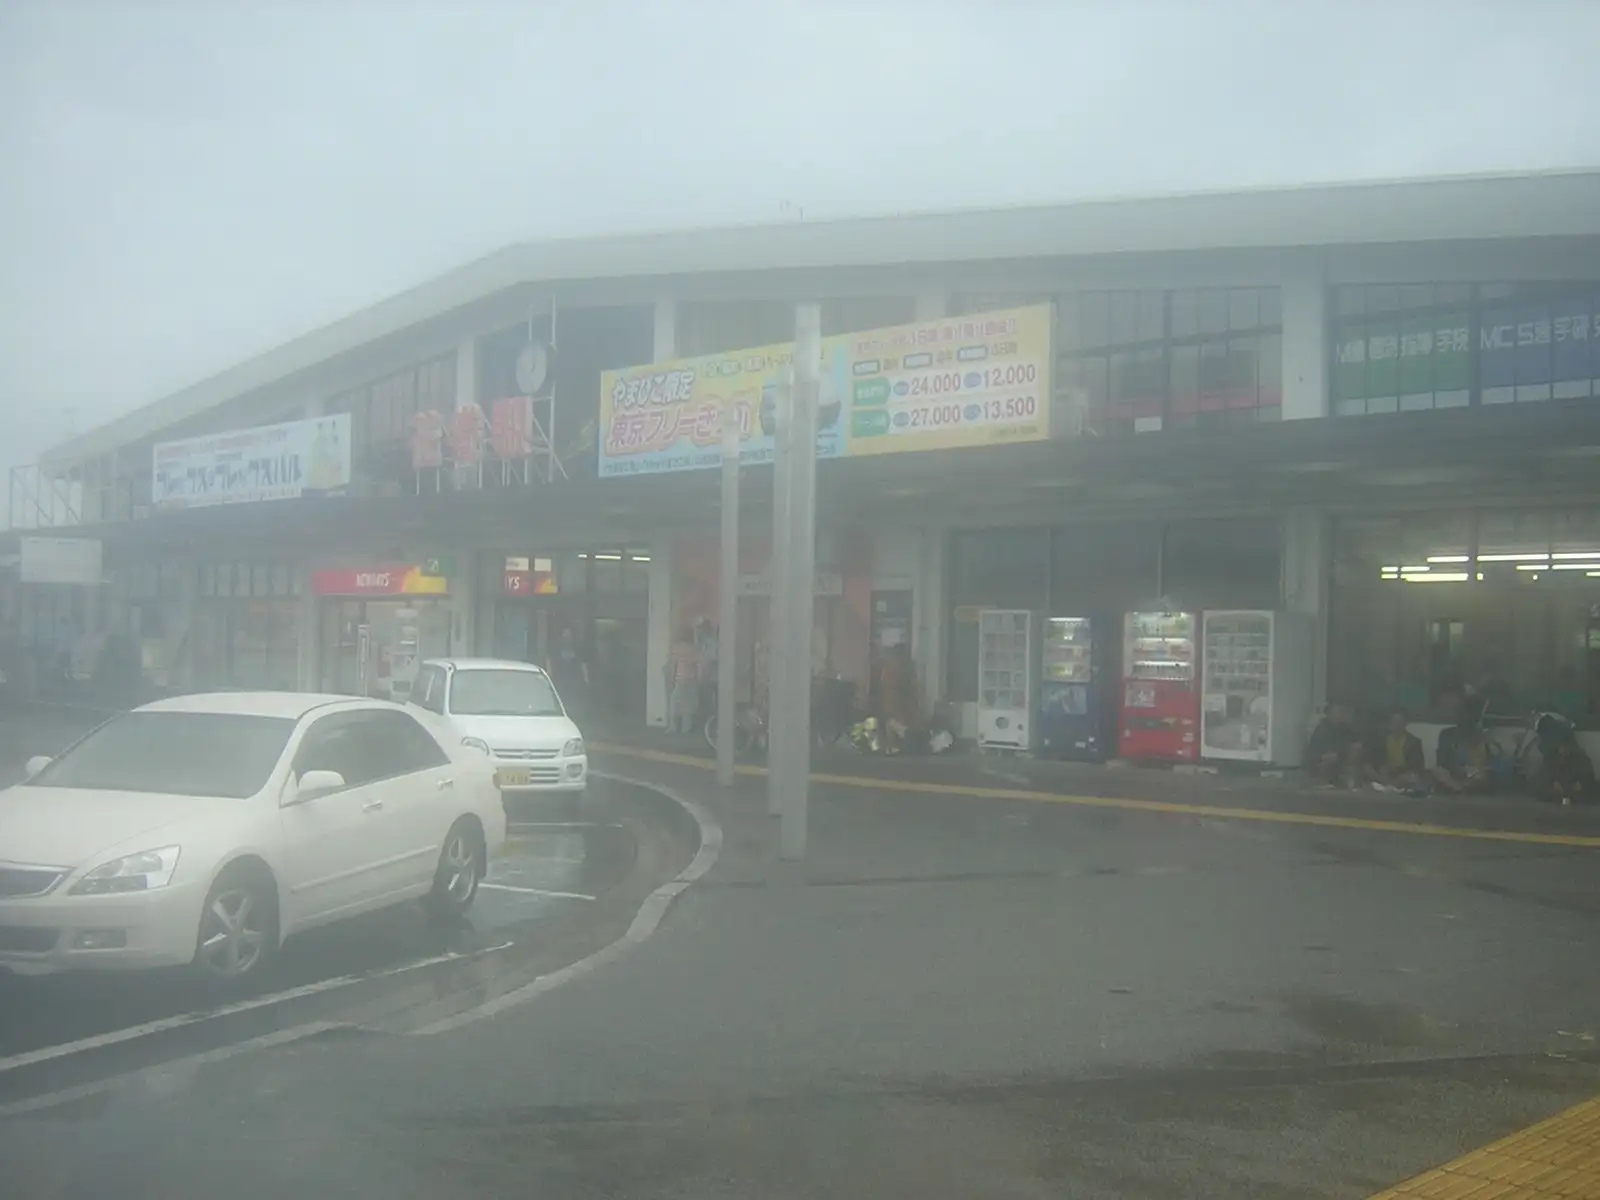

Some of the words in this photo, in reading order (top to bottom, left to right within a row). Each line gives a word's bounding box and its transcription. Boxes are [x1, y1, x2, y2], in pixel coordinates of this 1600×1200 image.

[612, 368, 695, 409] やまびこ限定
